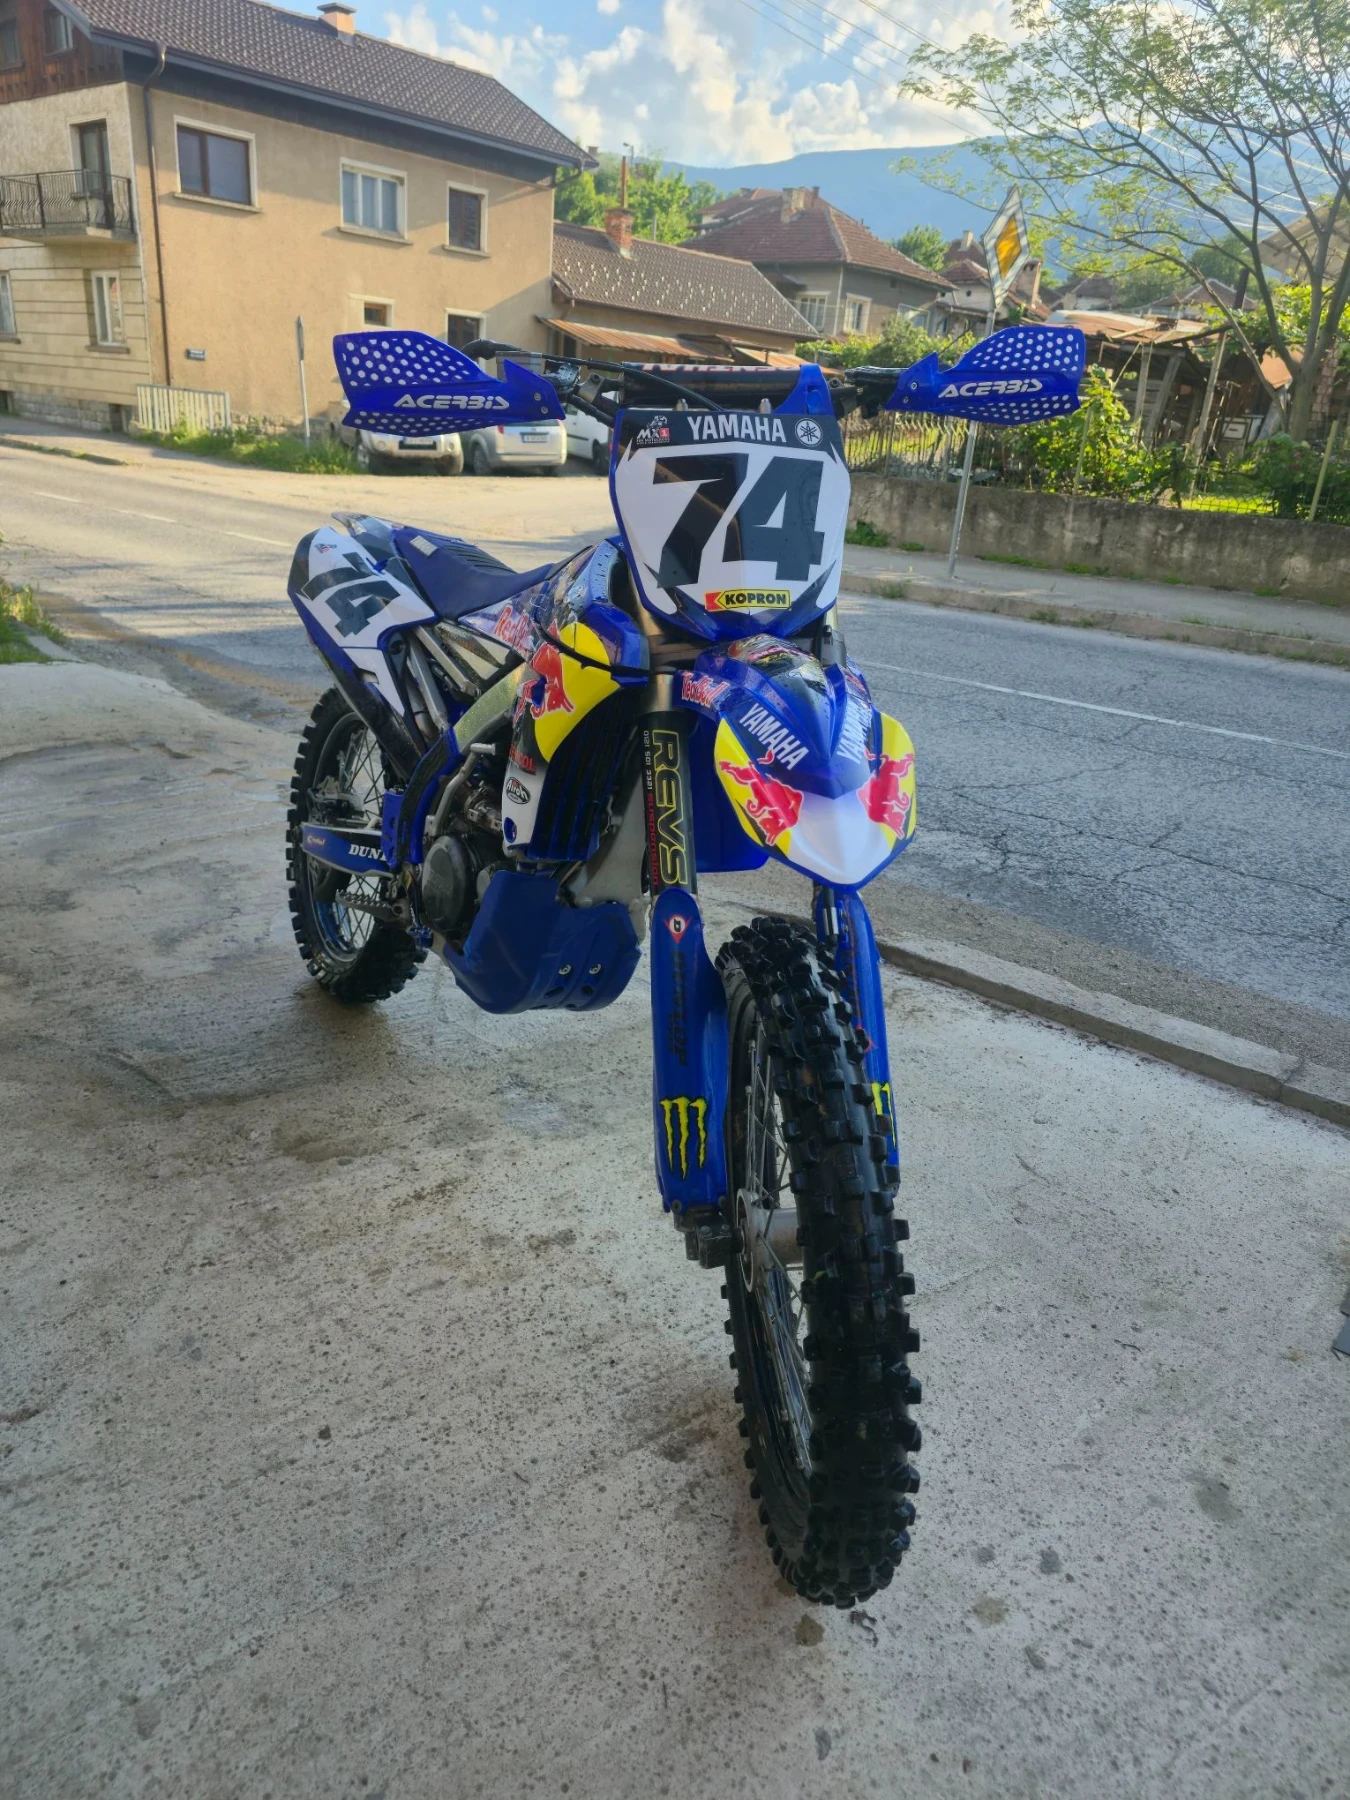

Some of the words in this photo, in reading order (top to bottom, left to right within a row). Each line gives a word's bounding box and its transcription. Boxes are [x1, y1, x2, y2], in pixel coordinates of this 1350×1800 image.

[393, 393, 510, 410] ACERBIS
[938, 378, 1043, 399] ACERBIS
[687, 414, 787, 443] YAMAHA
[653, 452, 825, 588] 74
[724, 590, 787, 606] KOPRON
[739, 702, 809, 771] YAMAHA
[652, 729, 688, 885] REVS
